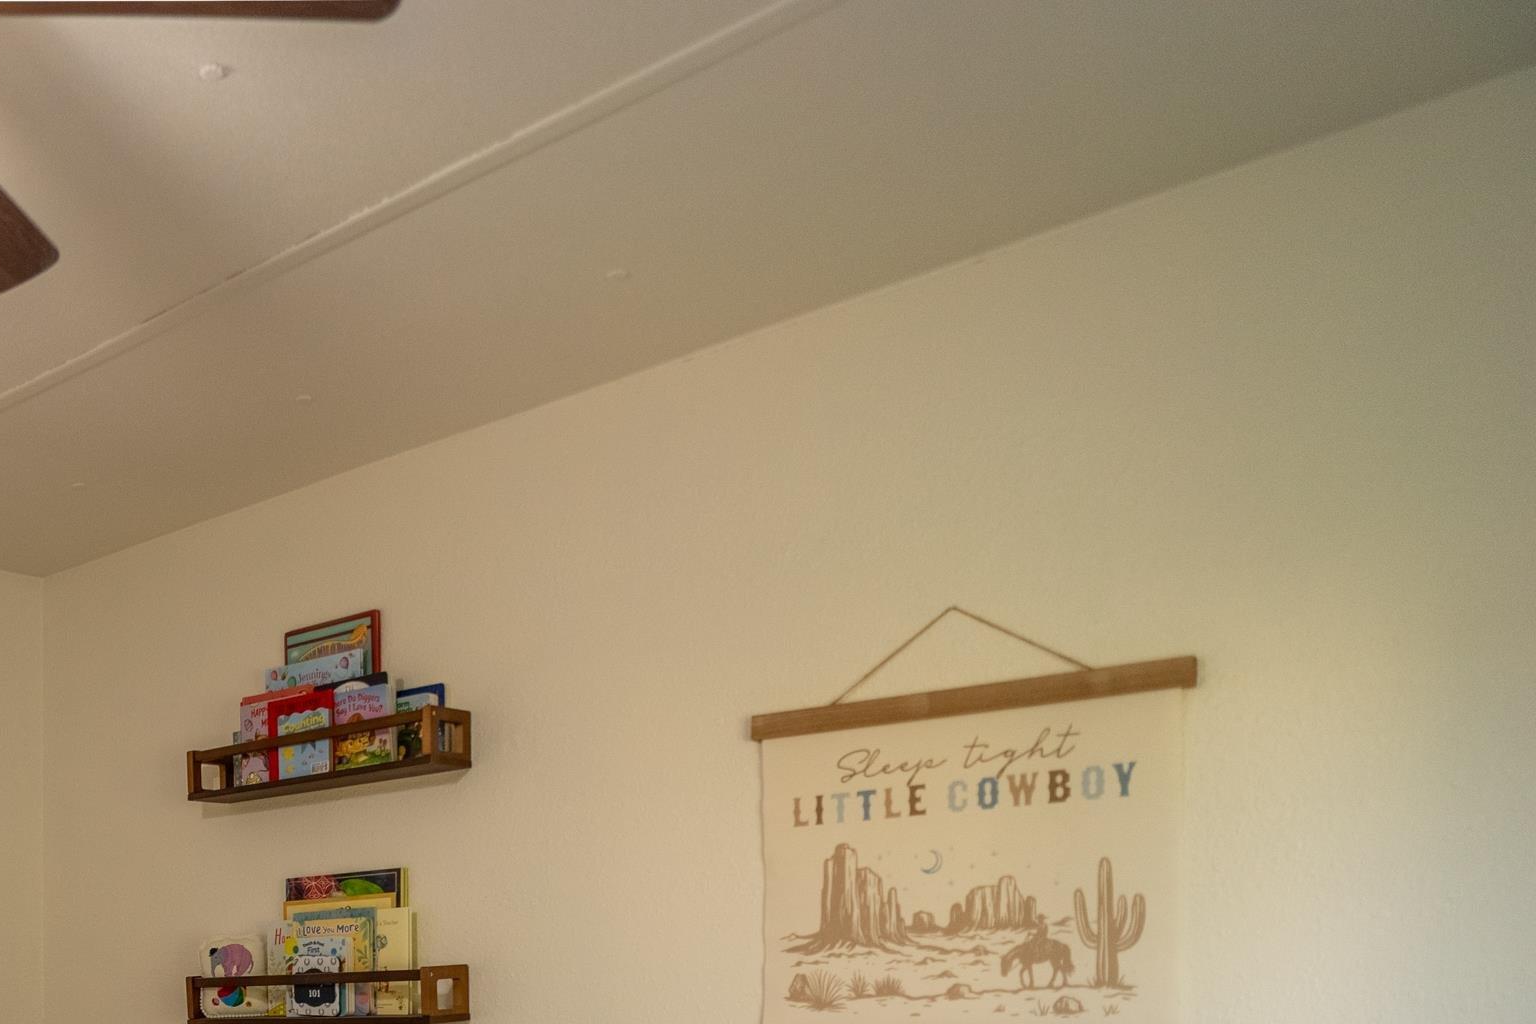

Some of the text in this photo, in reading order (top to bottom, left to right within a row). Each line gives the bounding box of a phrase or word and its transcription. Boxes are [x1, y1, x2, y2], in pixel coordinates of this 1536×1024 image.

[357, 692, 381, 705] Diggers
[250, 707, 267, 719] HAPP
[336, 706, 348, 718] Say
[352, 702, 367, 712] Love
[283, 714, 325, 733] Counting
[836, 722, 1081, 787] Sleep tight
[792, 761, 1138, 828] LITTLE COWBOY
[336, 924, 360, 934] More
[308, 988, 321, 998] 101
